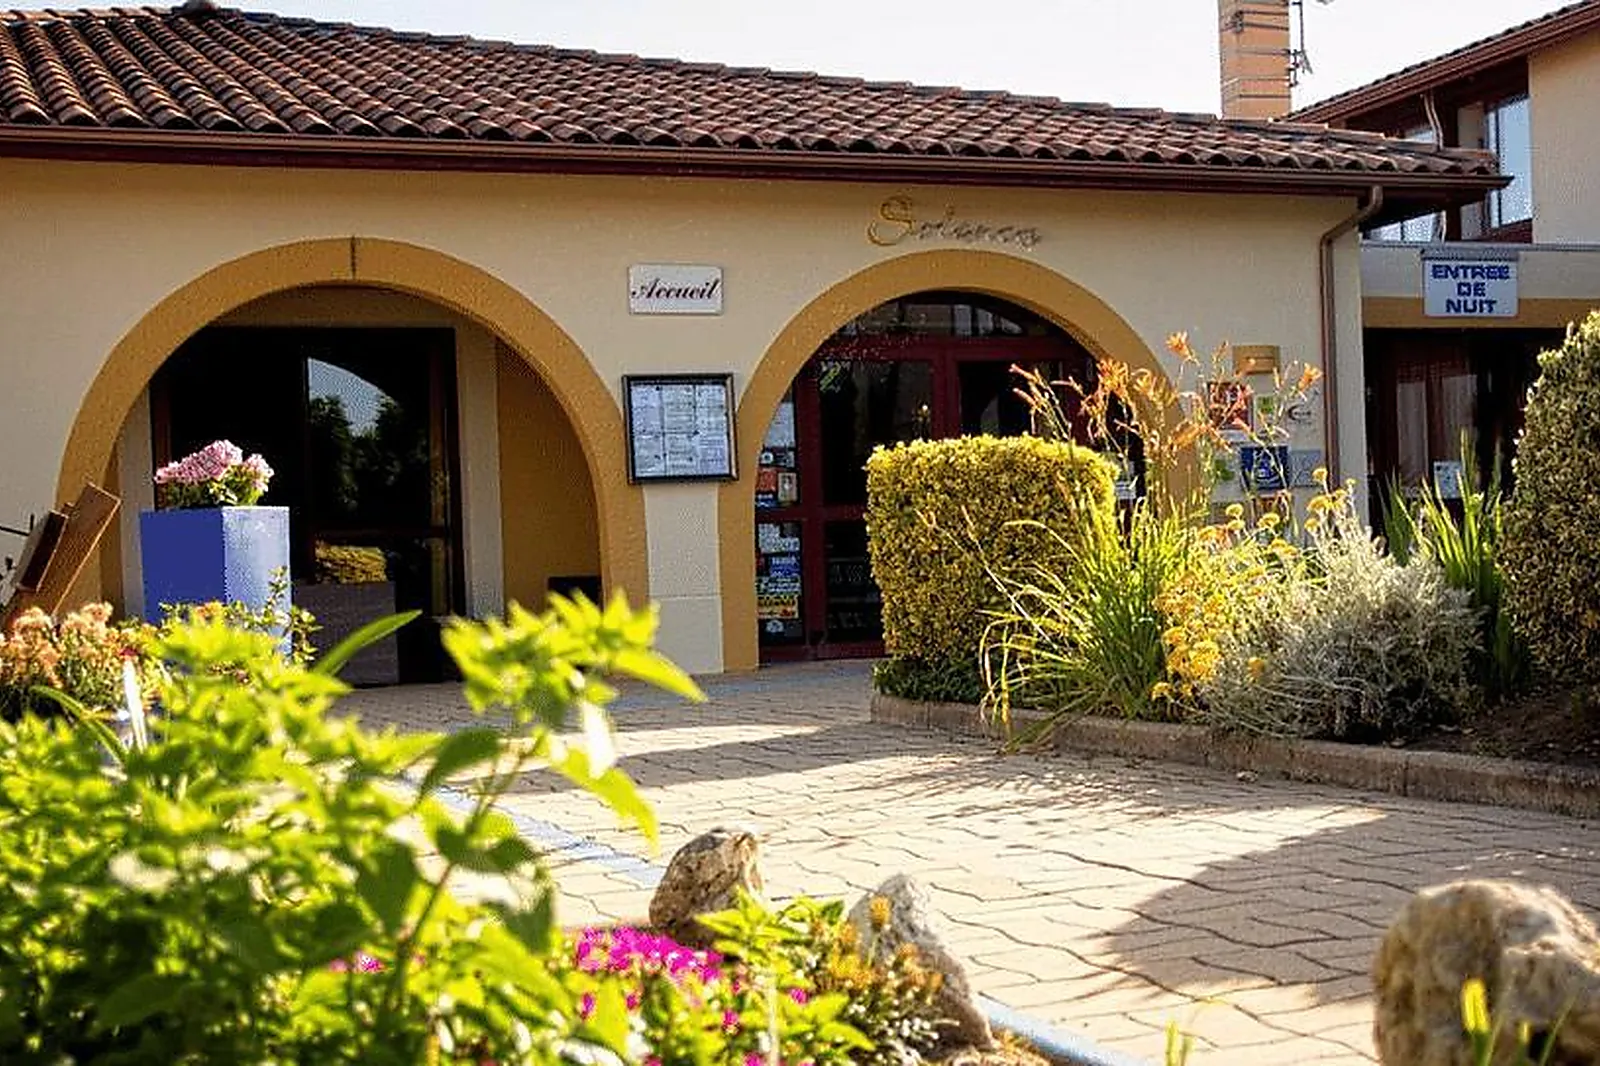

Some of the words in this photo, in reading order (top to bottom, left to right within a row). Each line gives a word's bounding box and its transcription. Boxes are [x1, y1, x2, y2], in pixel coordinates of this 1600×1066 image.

[1432, 264, 1510, 280] ENTREE
[632, 277, 720, 299] Accueil
[1457, 281, 1486, 297] DE
[1446, 298, 1497, 313] NUIT
